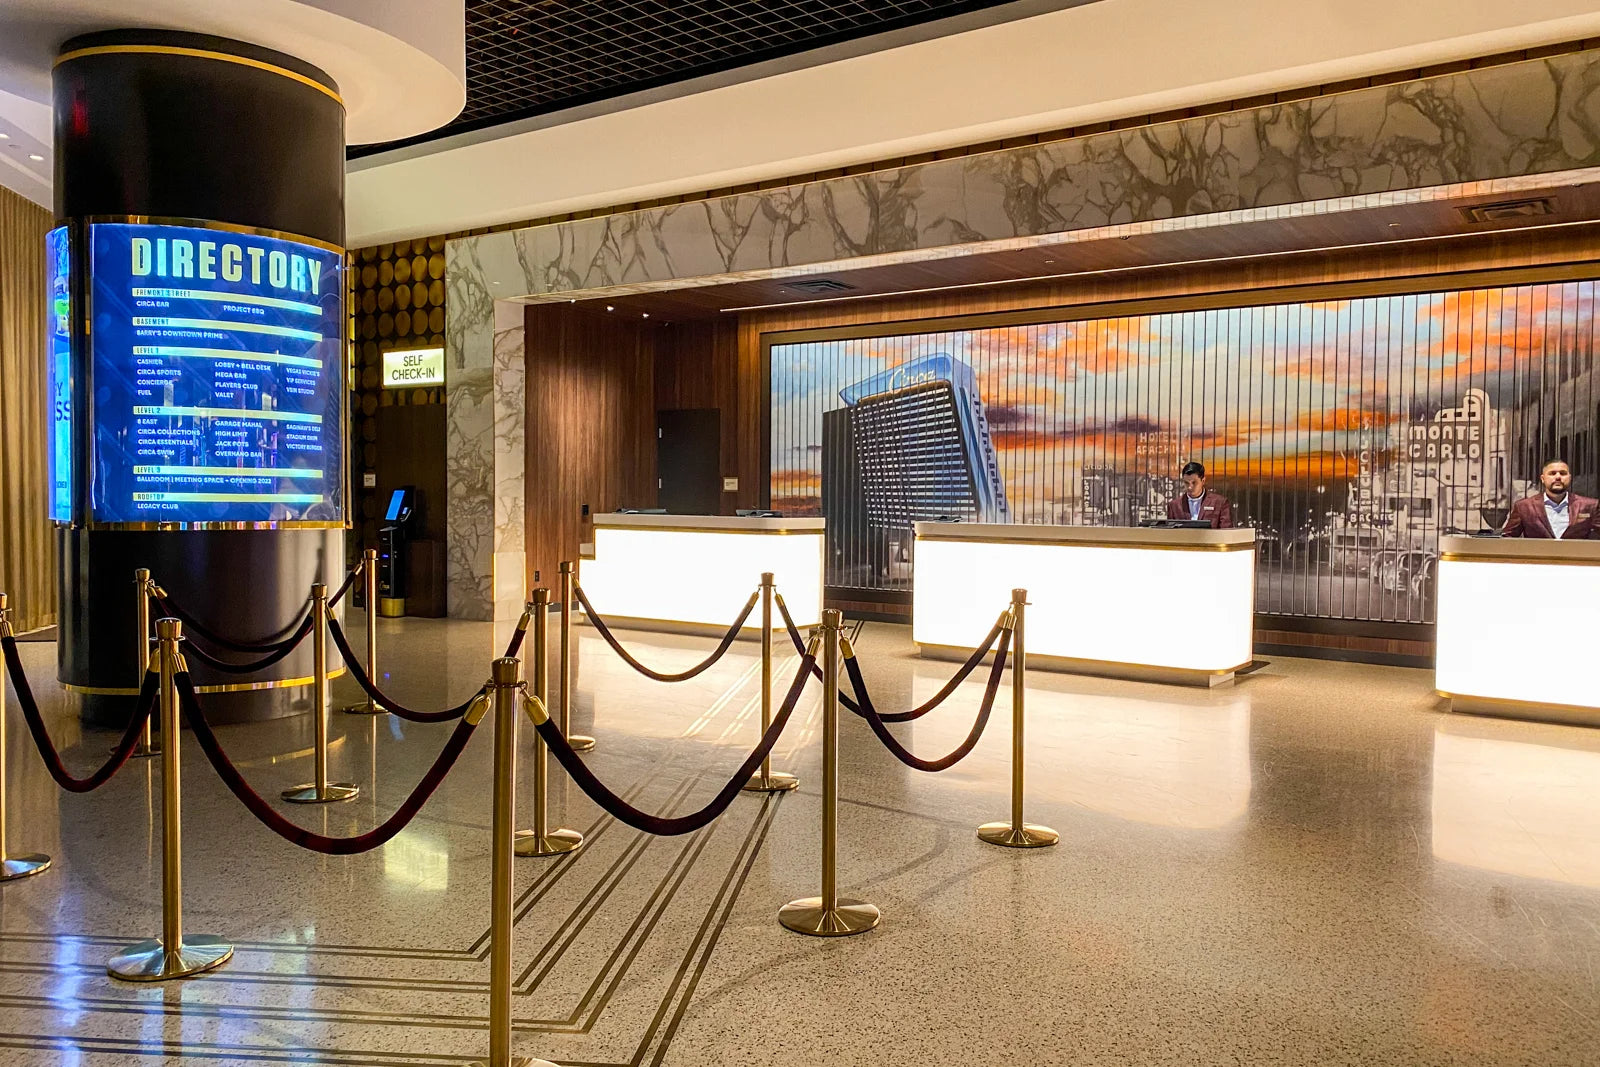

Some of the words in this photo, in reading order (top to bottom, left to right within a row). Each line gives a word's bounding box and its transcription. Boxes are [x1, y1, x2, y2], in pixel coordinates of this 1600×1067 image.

[131, 237, 322, 296] DIRECTORY
[223, 304, 251, 314] PROJECT
[162, 330, 202, 338] DOWNTOWN
[136, 358, 164, 366] CASHIER
[403, 354, 423, 367] SELF
[156, 369, 182, 377] SPORTS
[392, 368, 435, 380] CHECK-IN
[214, 382, 242, 390] PLAYERS
[888, 368, 936, 394] Circa
[242, 421, 262, 429] MAHAL
[1140, 432, 1176, 443] HOTEL
[1409, 426, 1480, 440] MONTE
[1408, 443, 1480, 459] CARLO
